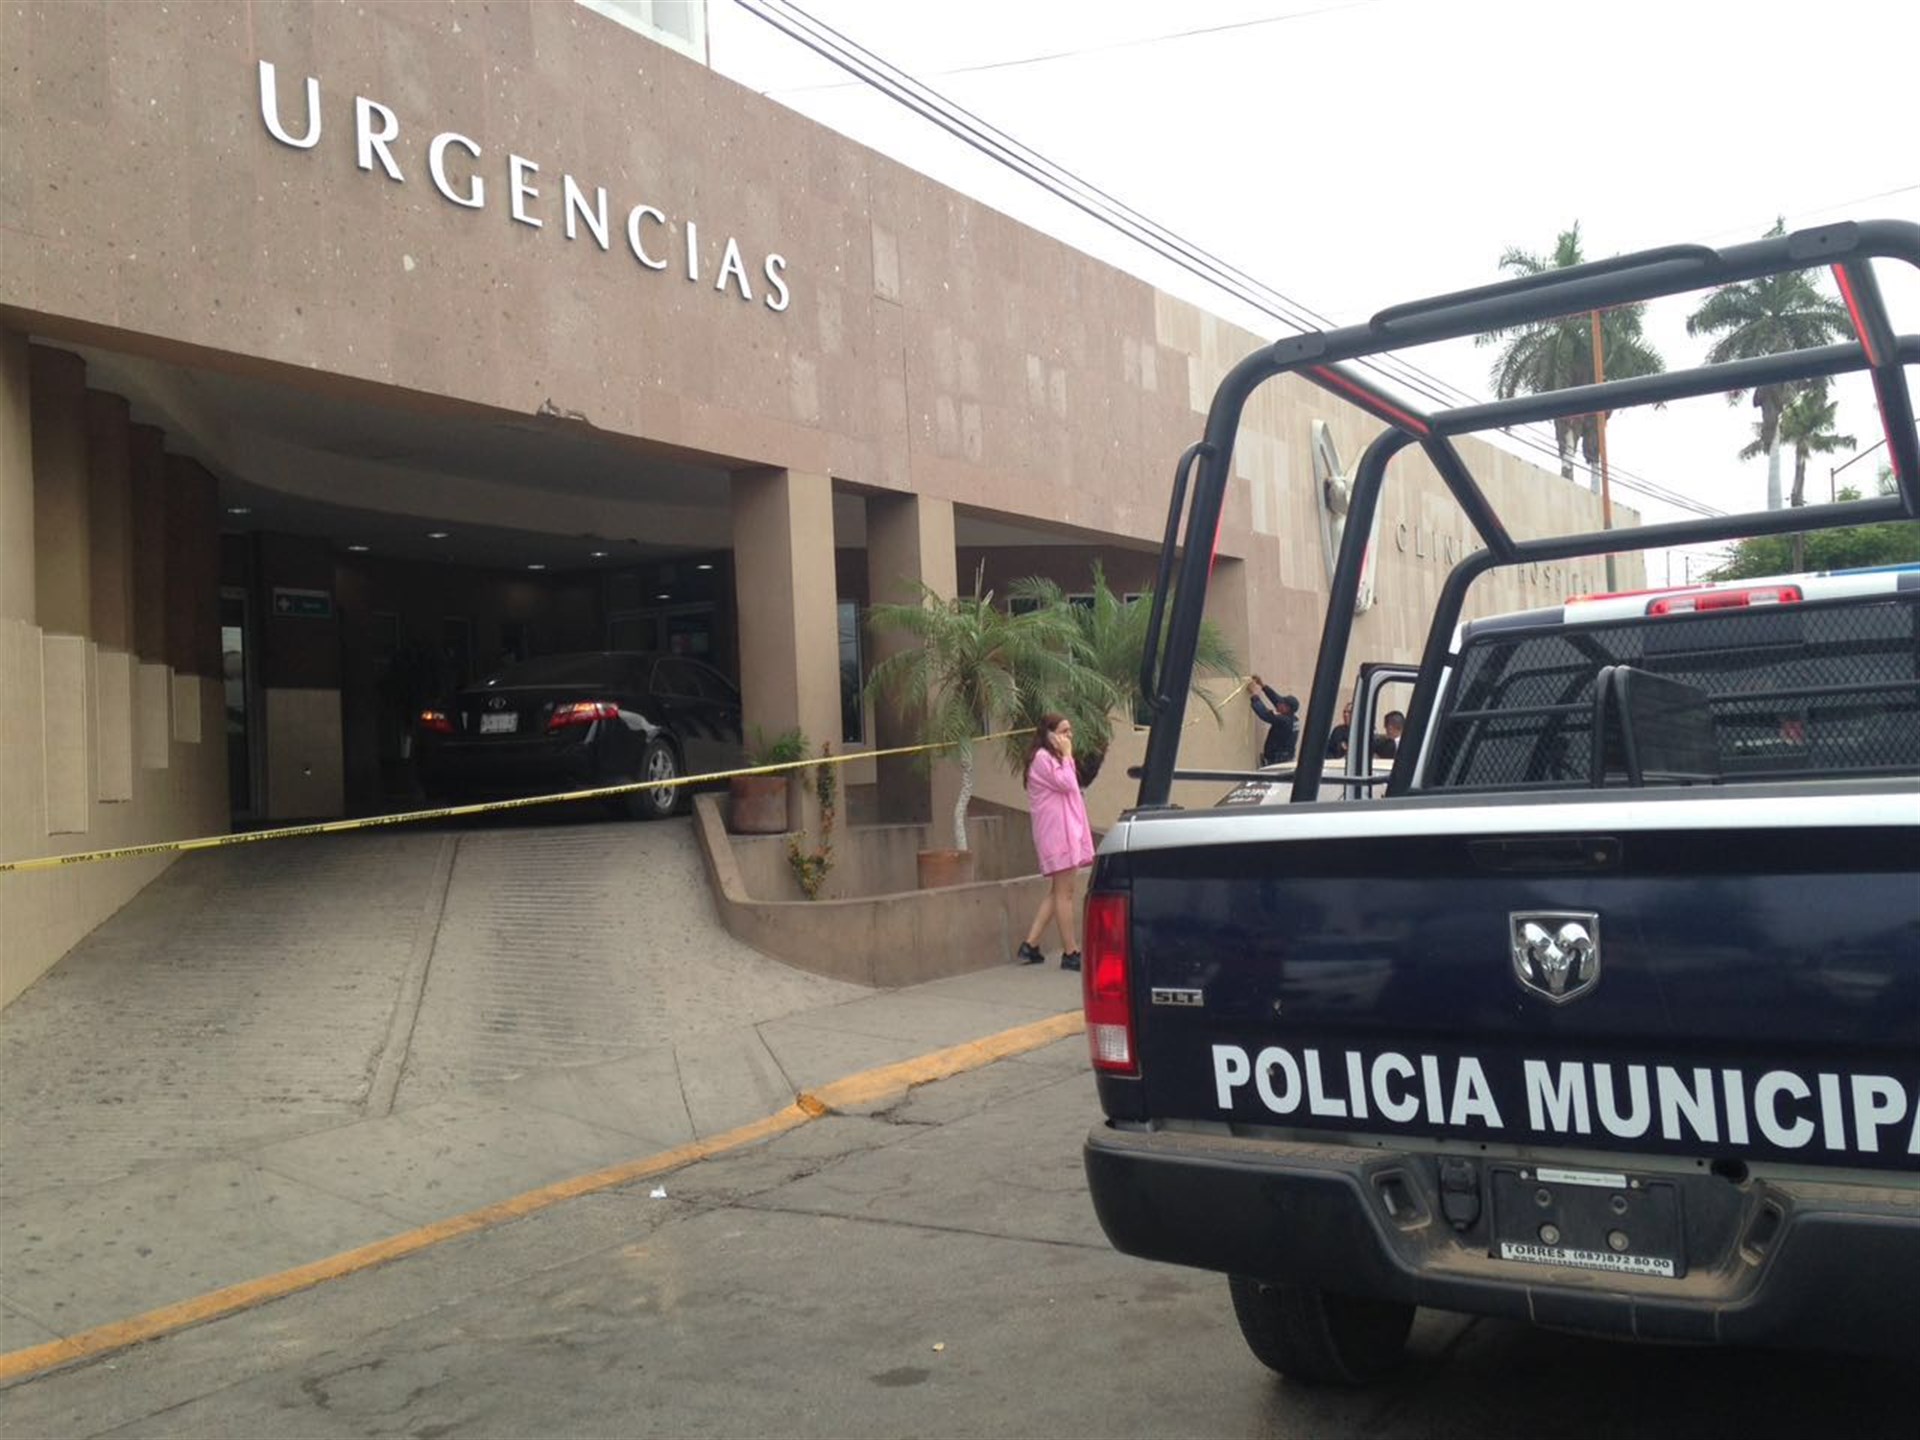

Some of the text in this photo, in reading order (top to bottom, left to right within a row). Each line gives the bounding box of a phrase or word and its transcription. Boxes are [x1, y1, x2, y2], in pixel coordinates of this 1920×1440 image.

[258, 60, 792, 313] URGENCIAS
[1211, 1044, 1920, 1154] POLICIA MUNICIP
[1506, 1244, 1670, 1268] TORRES (687)872 80 00
